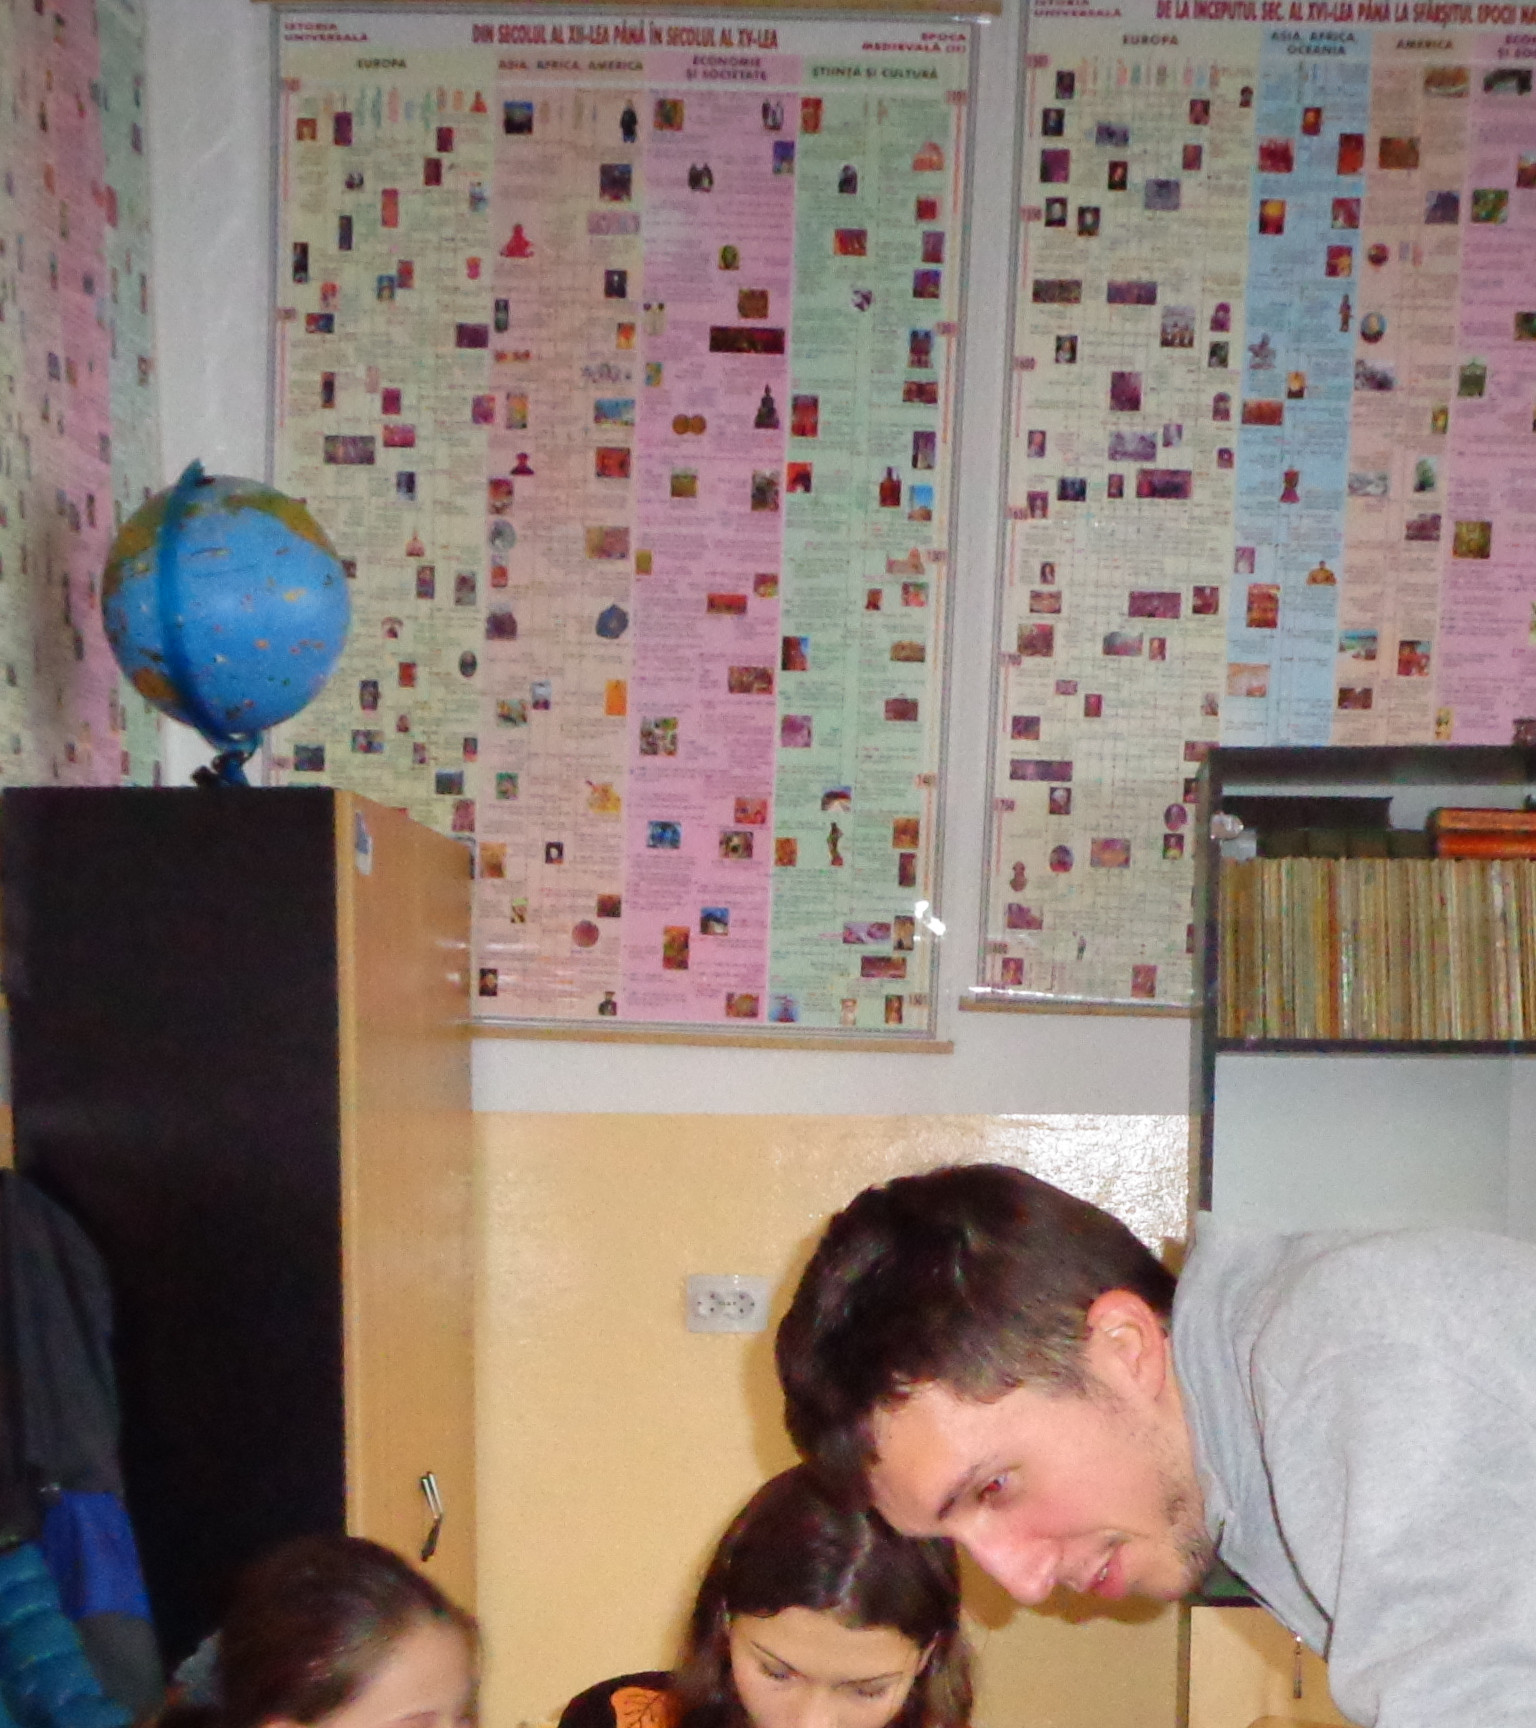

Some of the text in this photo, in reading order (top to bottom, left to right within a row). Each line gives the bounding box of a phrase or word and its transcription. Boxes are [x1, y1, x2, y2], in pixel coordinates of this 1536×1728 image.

[1122, 34, 1180, 45] EUROPA
[1396, 39, 1453, 49] AMERICA
[358, 59, 406, 69] EUROPA
